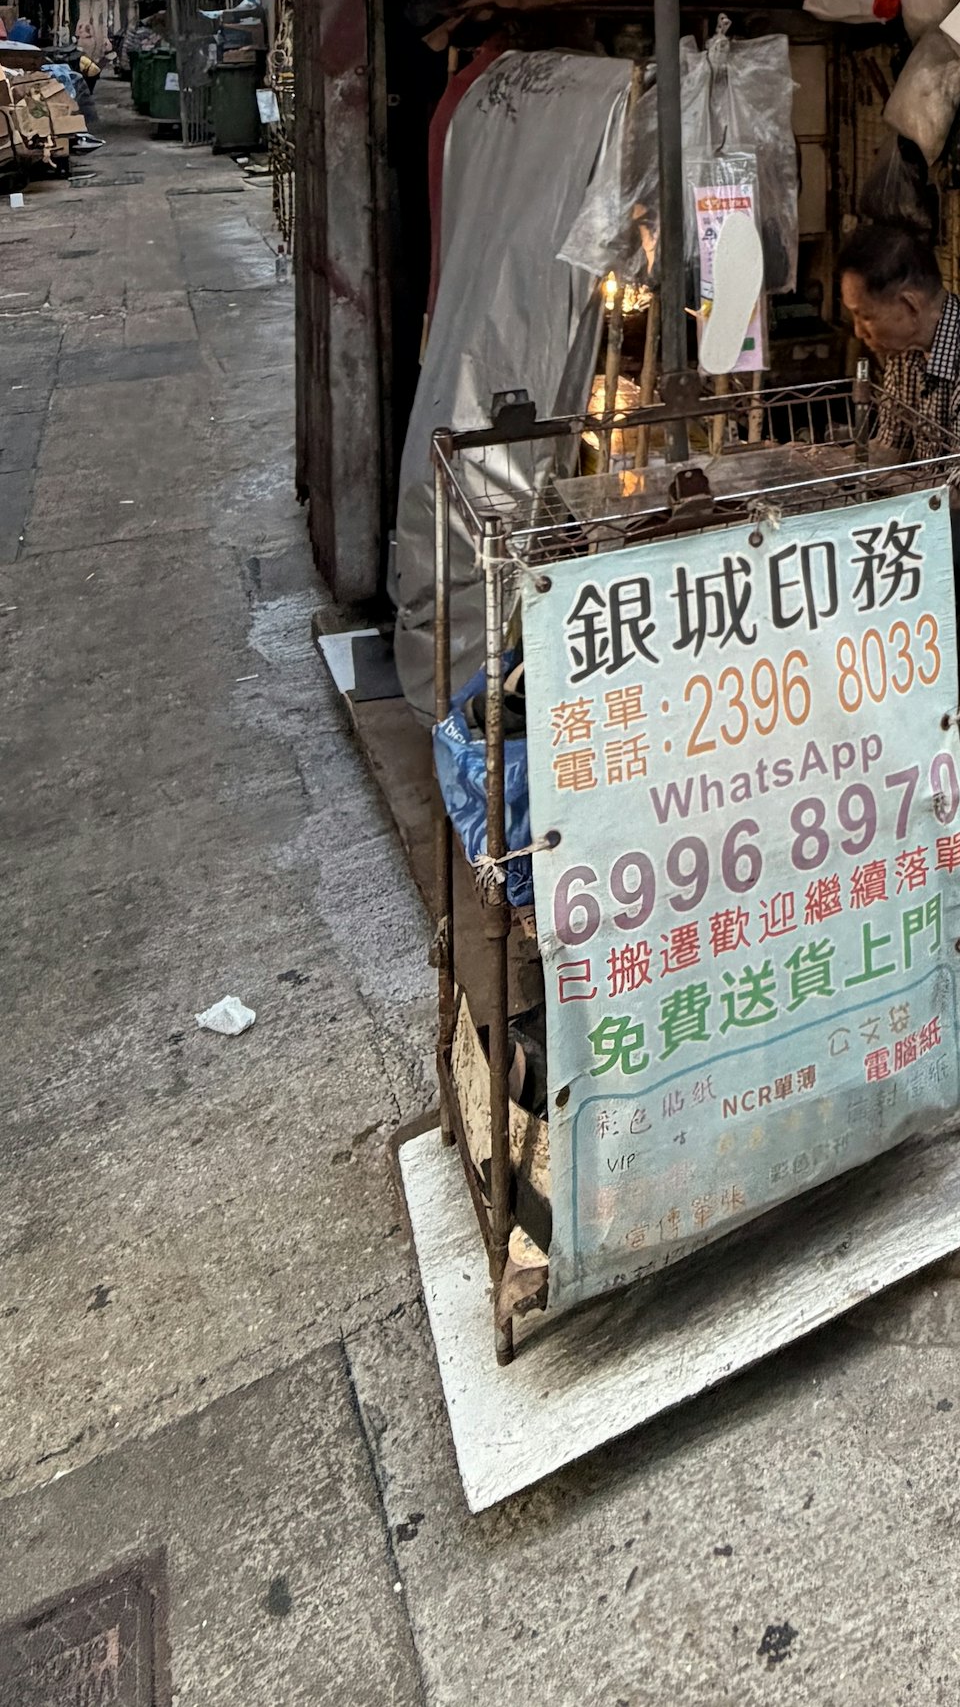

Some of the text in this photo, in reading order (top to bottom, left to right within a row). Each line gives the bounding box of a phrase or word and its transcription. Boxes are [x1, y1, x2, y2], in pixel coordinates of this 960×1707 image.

[566, 520, 926, 684] 銀城印務
[835, 613, 942, 714] 8033
[549, 683, 648, 747] 落單
[649, 733, 885, 825] WhatsApp
[552, 817, 764, 949] 6996
[586, 893, 943, 1080] 免費送貨上門
[864, 1015, 943, 1084] 電腦紙
[607, 1152, 637, 1173] VIP
